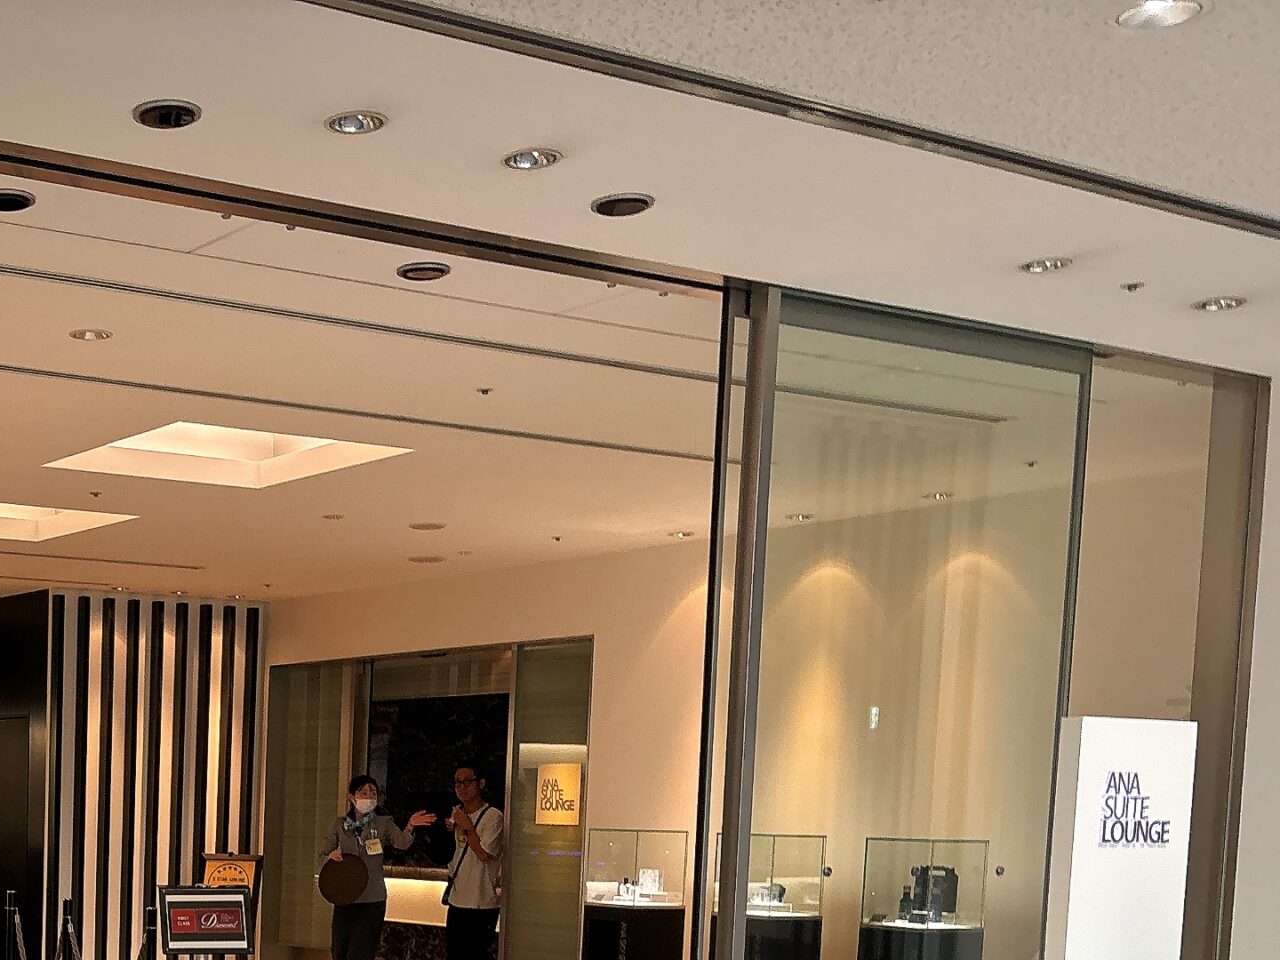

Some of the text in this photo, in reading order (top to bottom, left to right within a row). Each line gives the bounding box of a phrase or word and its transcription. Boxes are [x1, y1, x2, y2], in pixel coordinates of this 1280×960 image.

[541, 778, 560, 791] ANA
[1105, 771, 1141, 795] ANA
[541, 789, 564, 801] SUITE
[540, 800, 575, 811] LOUNGE
[1103, 794, 1150, 820] SUITE
[1101, 820, 1171, 843] LOUNGE
